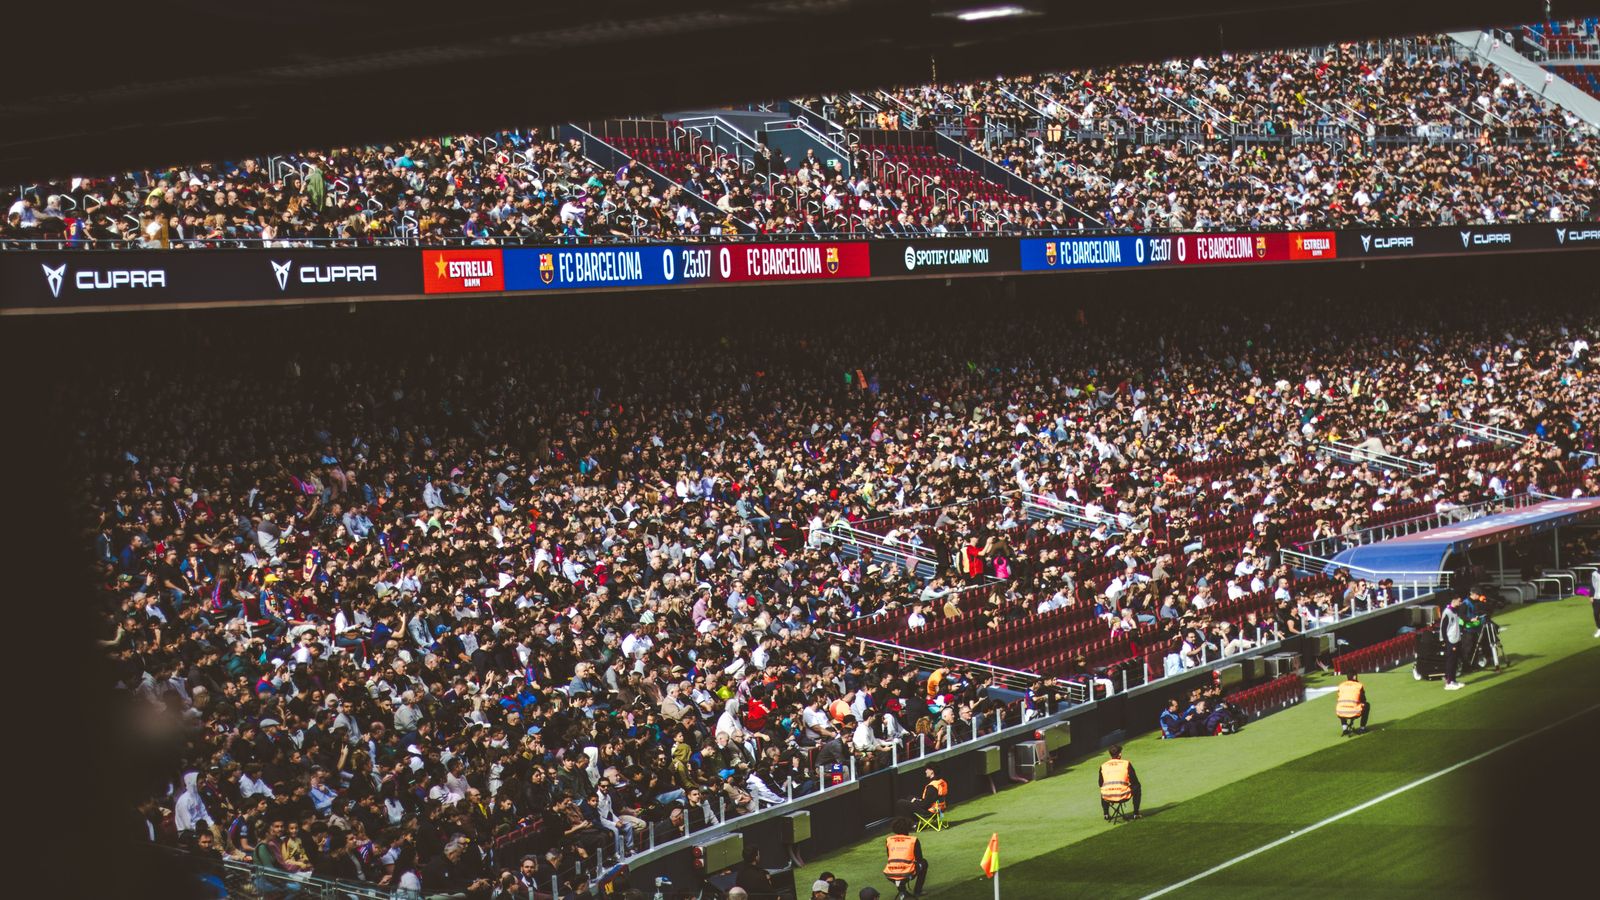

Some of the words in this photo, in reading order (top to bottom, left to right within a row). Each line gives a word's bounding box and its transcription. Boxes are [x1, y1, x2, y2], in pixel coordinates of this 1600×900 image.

[1303, 239, 1331, 251] ESTRELLA
[1374, 236, 1414, 249] CUPRA
[1473, 233, 1512, 244] CUPRA
[916, 249, 949, 266] SPOTIFY
[949, 248, 972, 265] CAMP
[972, 248, 989, 264] NOU
[1060, 240, 1072, 265] FC
[1072, 239, 1122, 264] BARCELONA
[1135, 238, 1145, 263] 0
[1149, 239, 1172, 262] 25:07
[1177, 237, 1186, 262] 0
[1196, 237, 1208, 260] FC
[1208, 236, 1254, 259] BARCELONA
[448, 260, 494, 278] ESTRELLA
[559, 252, 574, 283] FC
[574, 251, 643, 282] BARCELONA
[663, 248, 675, 281] 0
[682, 248, 712, 278] 25:07
[720, 247, 732, 279] 0
[746, 248, 761, 276] FC
[761, 248, 822, 276] BARCELONA
[75, 270, 166, 290] CUPRA
[299, 265, 377, 284] CUPRA
